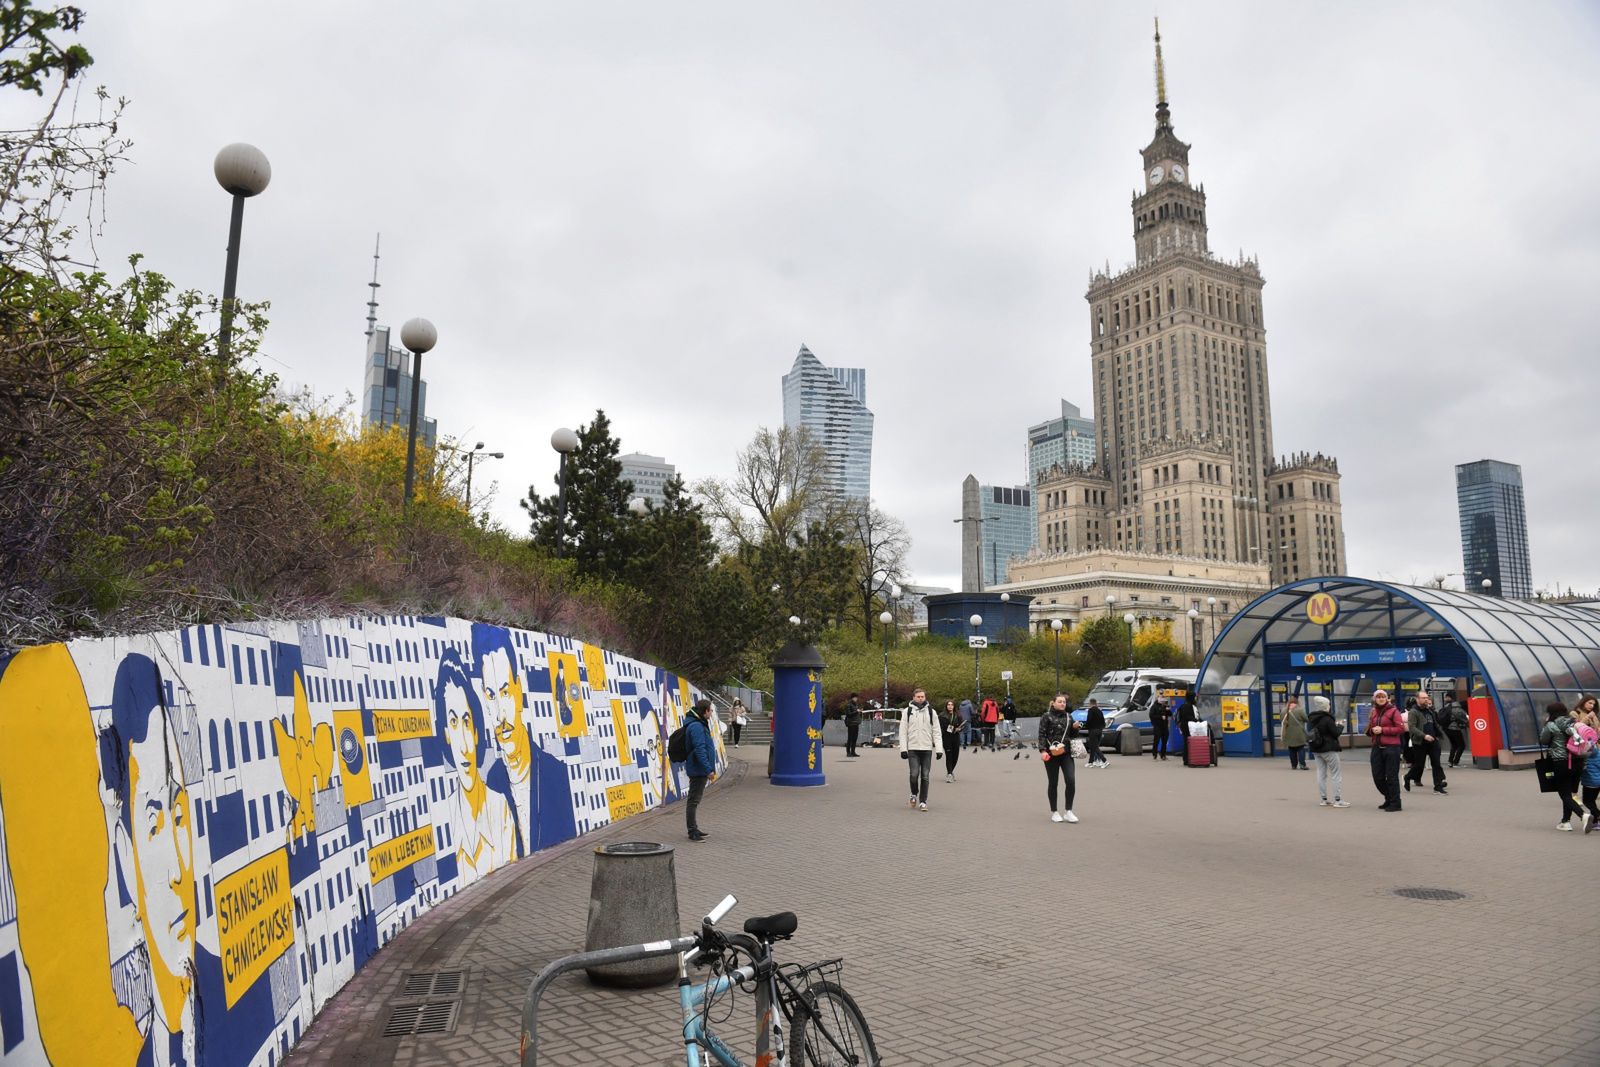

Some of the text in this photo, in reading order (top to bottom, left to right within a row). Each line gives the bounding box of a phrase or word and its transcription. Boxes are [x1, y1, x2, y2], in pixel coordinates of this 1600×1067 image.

[1318, 653, 1360, 663] Centrum
[370, 831, 433, 877] CYWIA LUBETKIN
[219, 866, 279, 934] STANISŁAW
